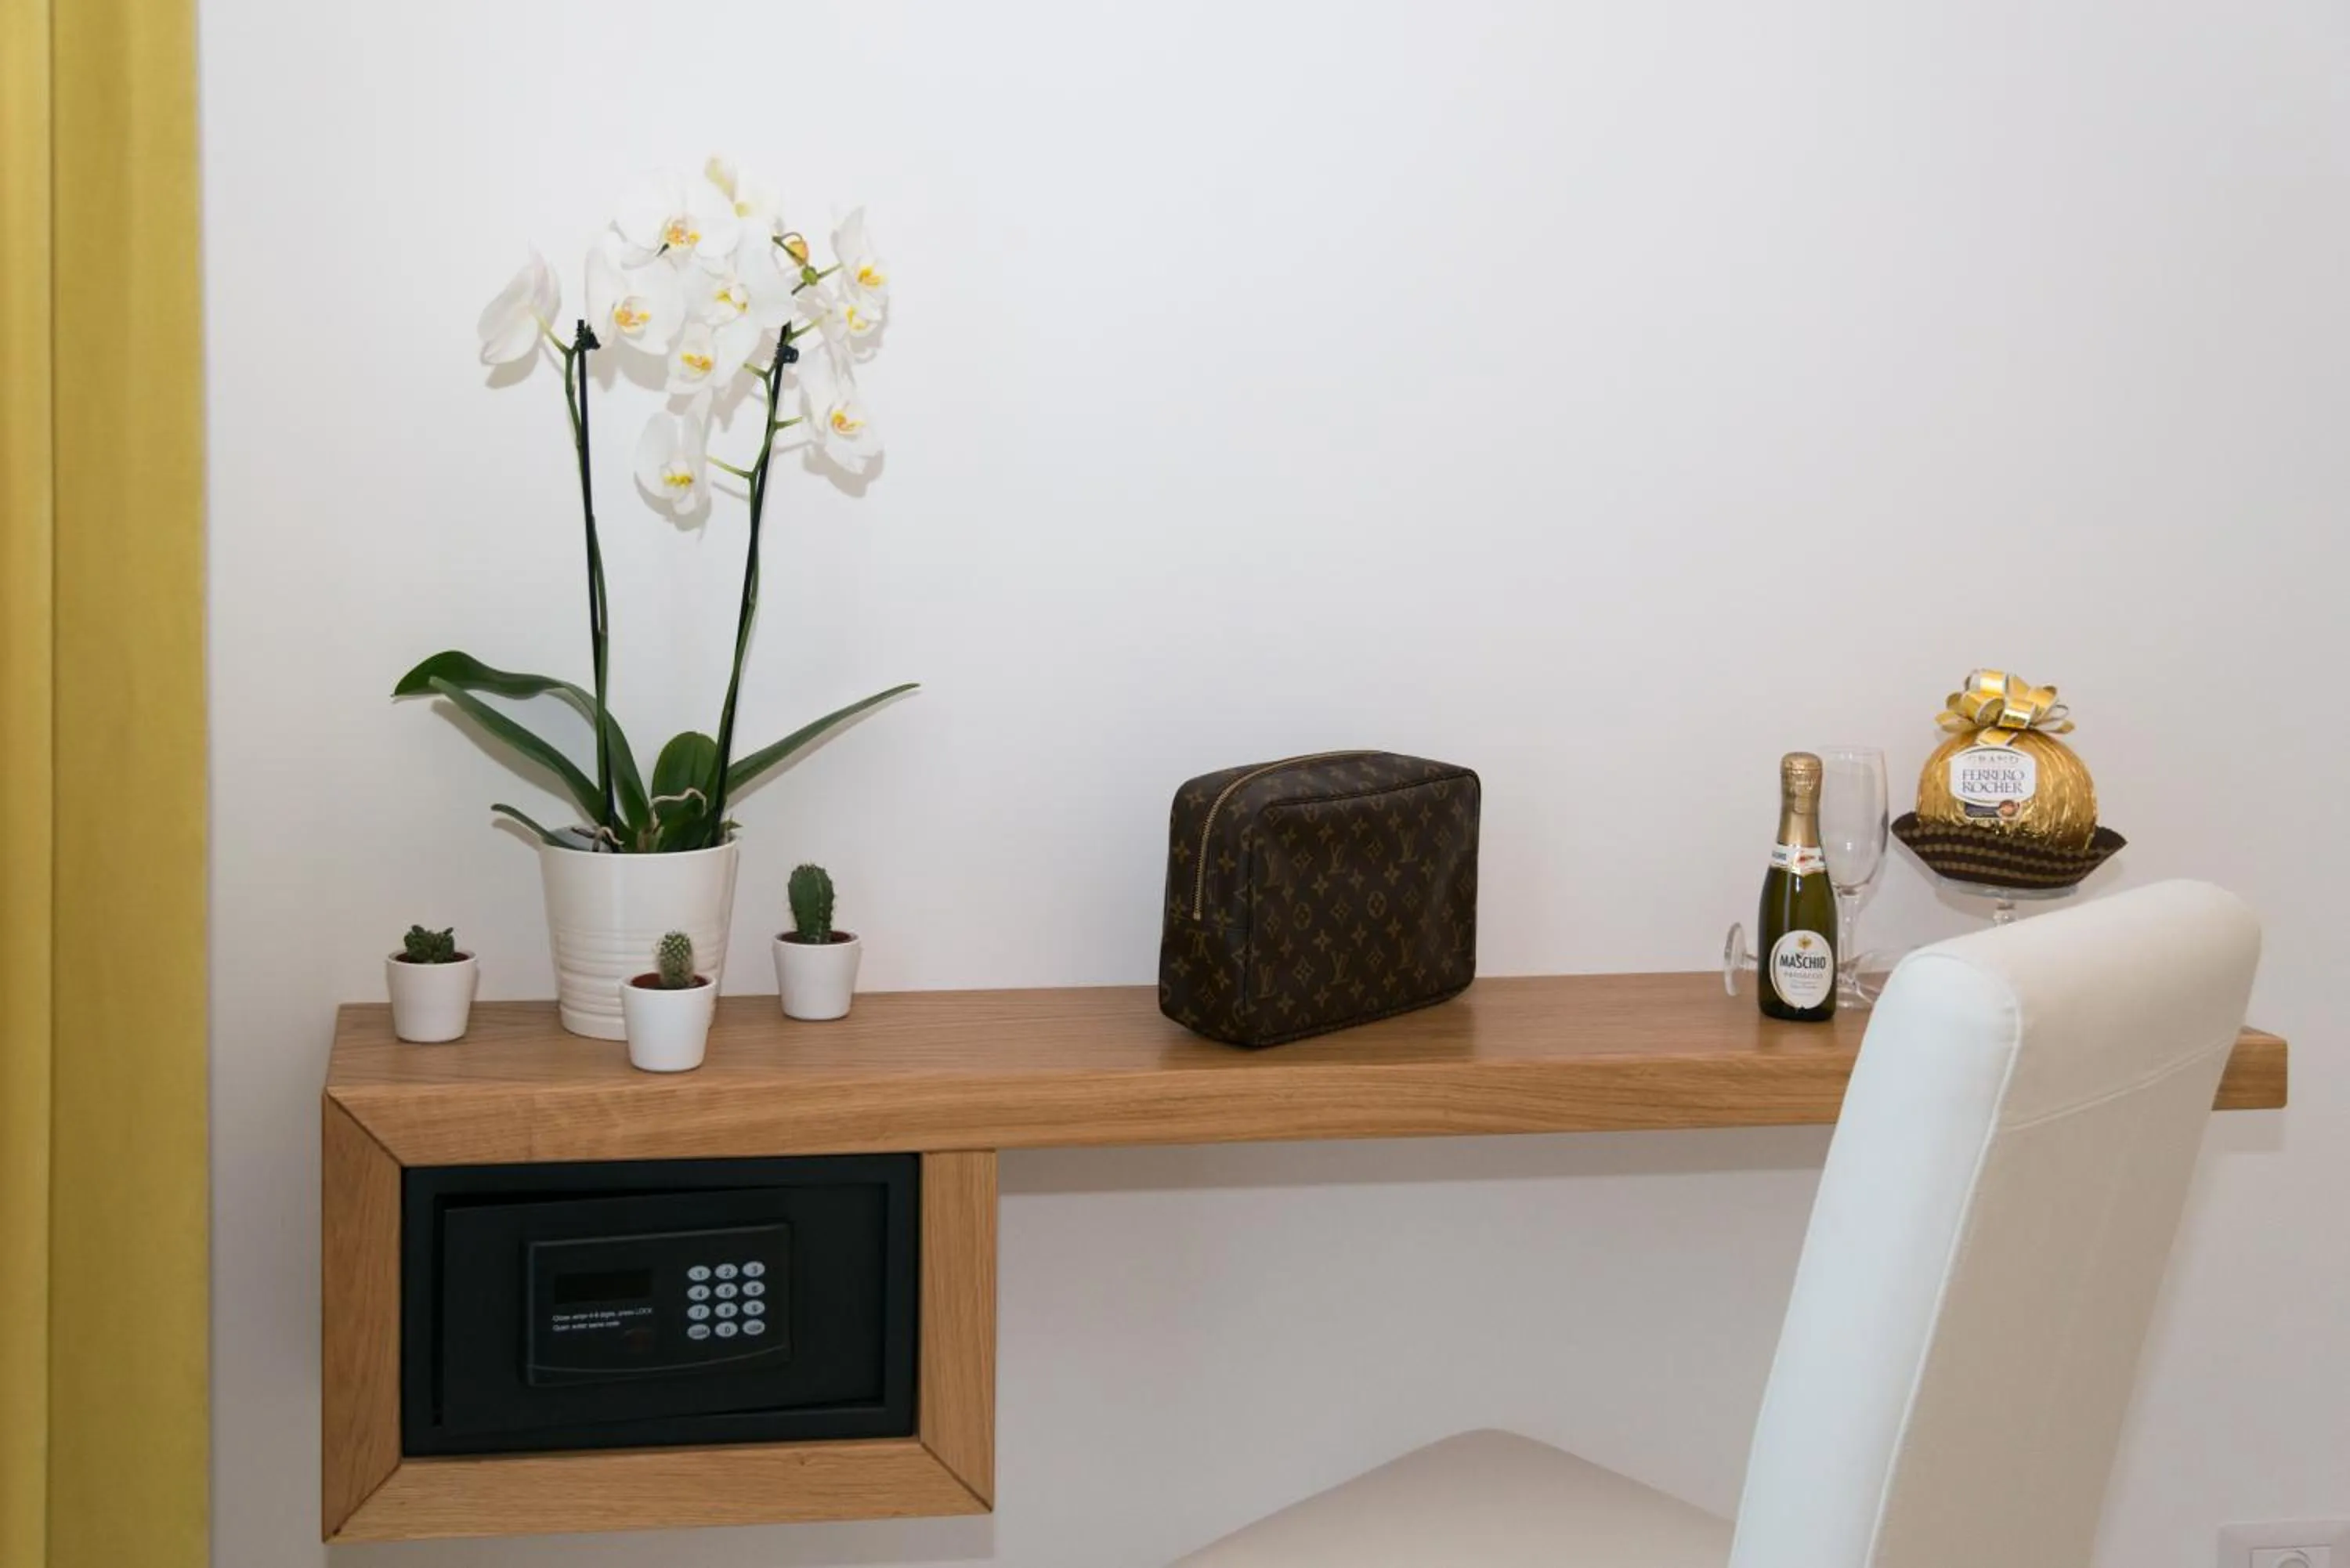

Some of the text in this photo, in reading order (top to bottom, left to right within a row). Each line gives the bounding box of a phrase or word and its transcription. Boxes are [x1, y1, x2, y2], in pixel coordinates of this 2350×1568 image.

[1962, 768, 2025, 781] FERRERO
[1962, 782, 2023, 794] ROCHER
[1779, 952, 1827, 970] MASCHIO
[724, 1267, 732, 1277] 2
[696, 1288, 703, 1298] 4
[725, 1325, 731, 1335] 0
